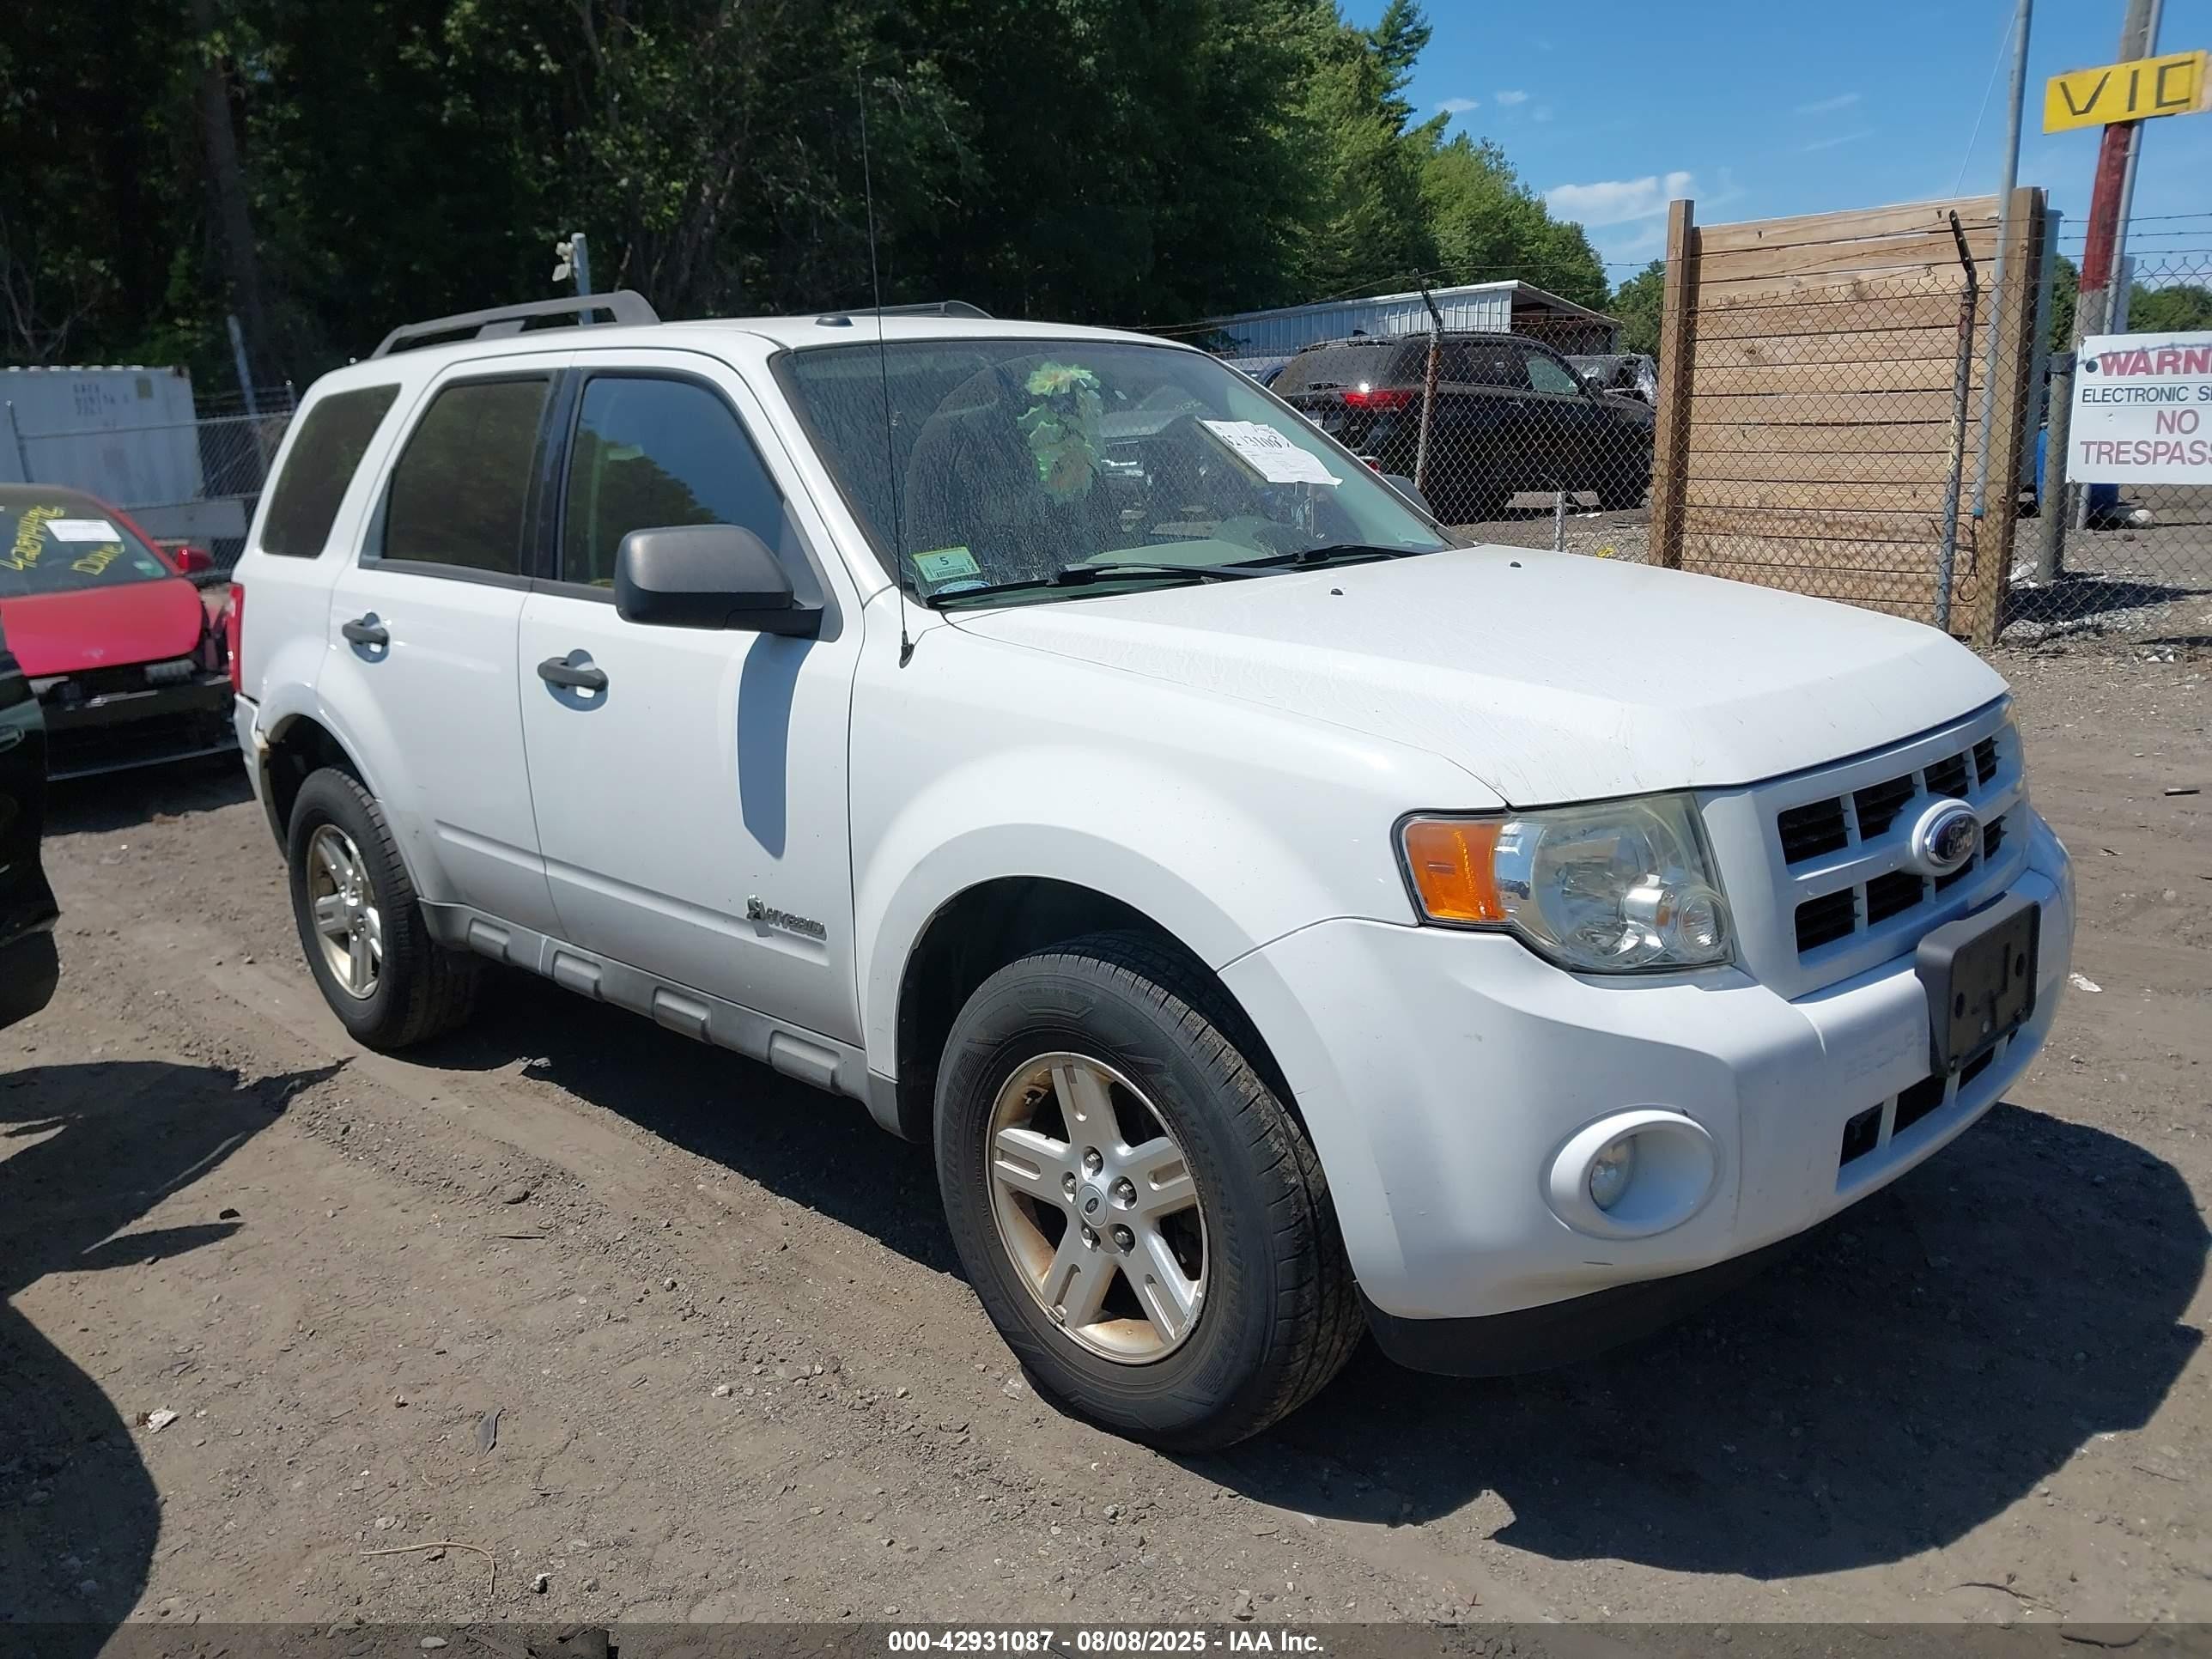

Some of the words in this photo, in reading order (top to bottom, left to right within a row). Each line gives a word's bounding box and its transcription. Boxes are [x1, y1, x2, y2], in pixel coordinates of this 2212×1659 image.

[2100, 349, 2212, 376] WARN
[2081, 386, 2189, 404] ELECTRONIC
[2155, 409, 2200, 434] NO
[2080, 440, 2212, 466] TRESPAS
[939, 556, 950, 566] 5
